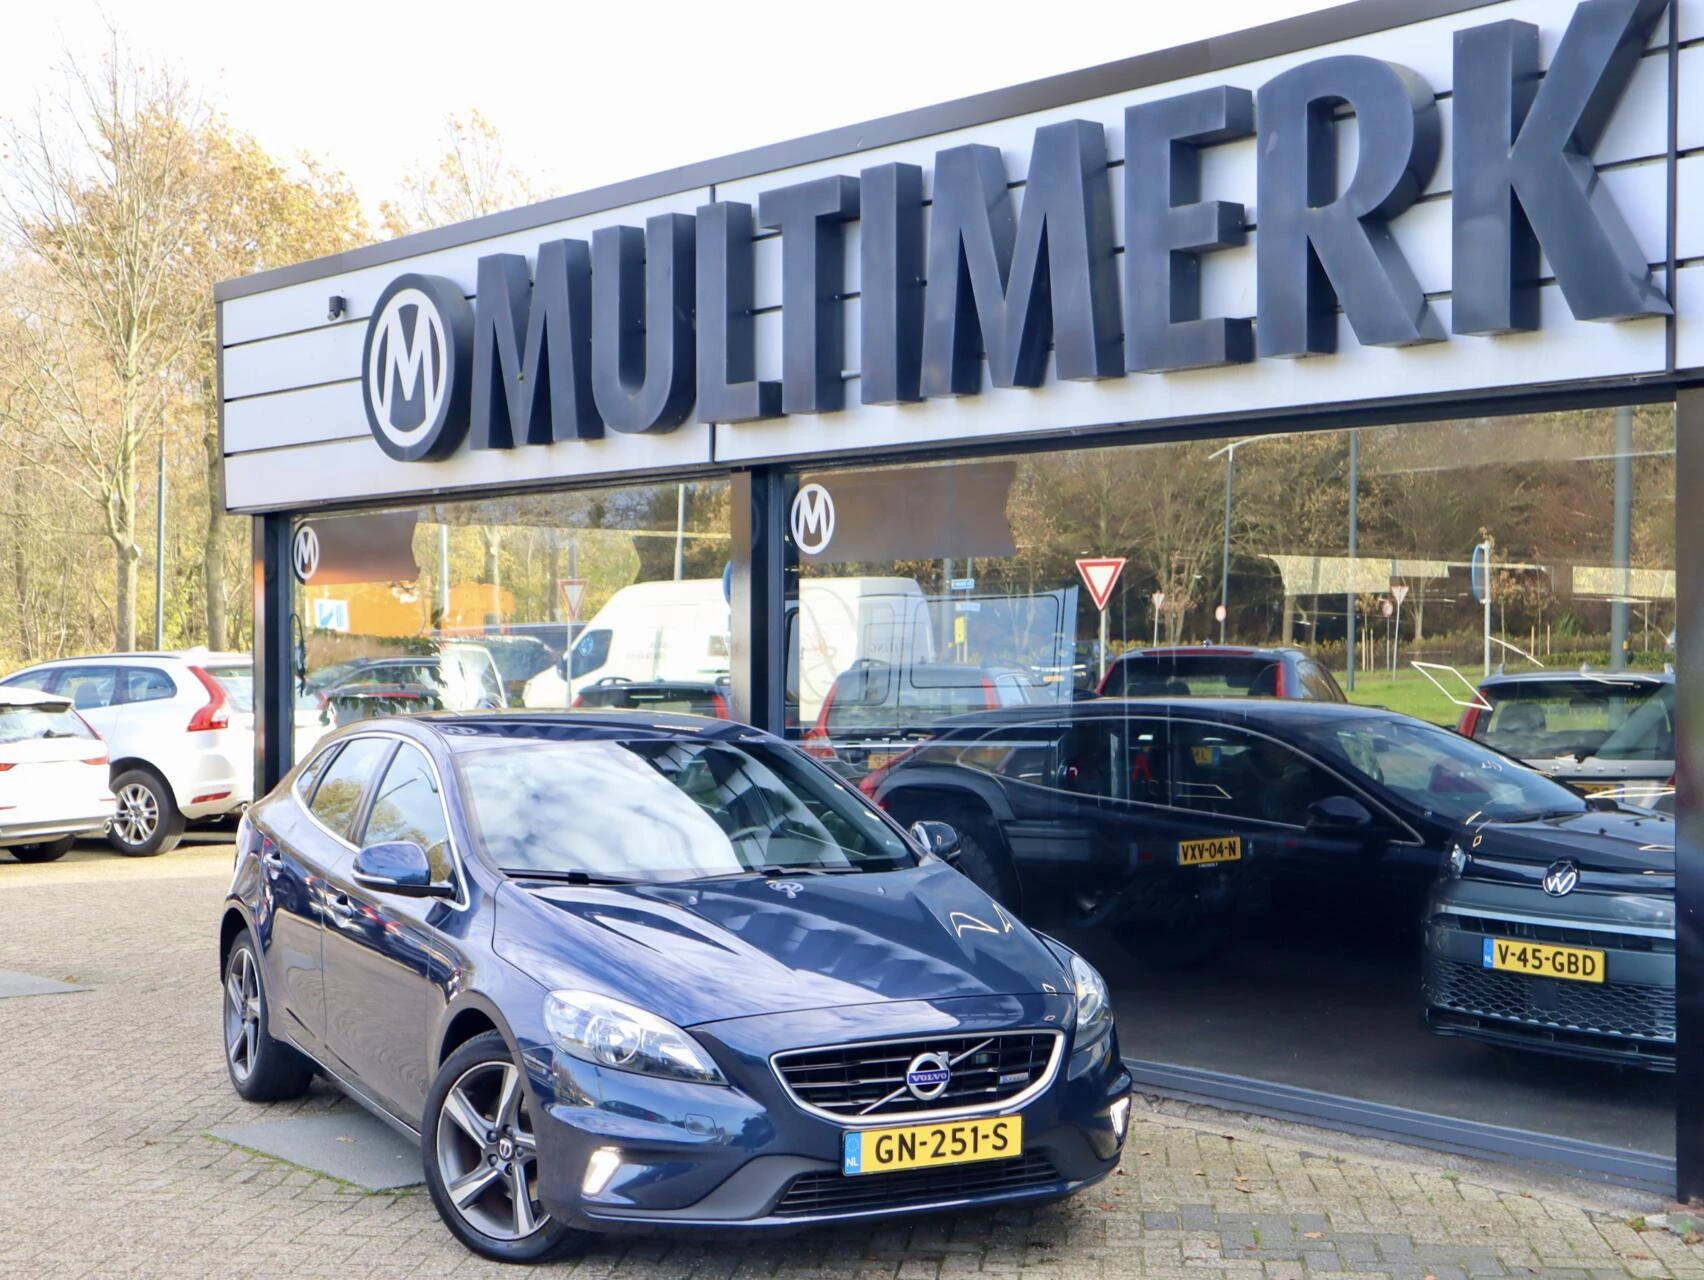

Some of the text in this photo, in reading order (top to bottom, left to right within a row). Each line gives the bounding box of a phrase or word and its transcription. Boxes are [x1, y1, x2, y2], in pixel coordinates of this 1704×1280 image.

[369, 0, 1674, 450] M MULTIMERK
[790, 482, 835, 555] M
[293, 526, 319, 580] M
[1181, 839, 1237, 861] VXV-04-N
[1498, 943, 1597, 977] V-45-GBD
[911, 1071, 948, 1083] VOLVO
[846, 1122, 1009, 1168] NL GN-251-S
